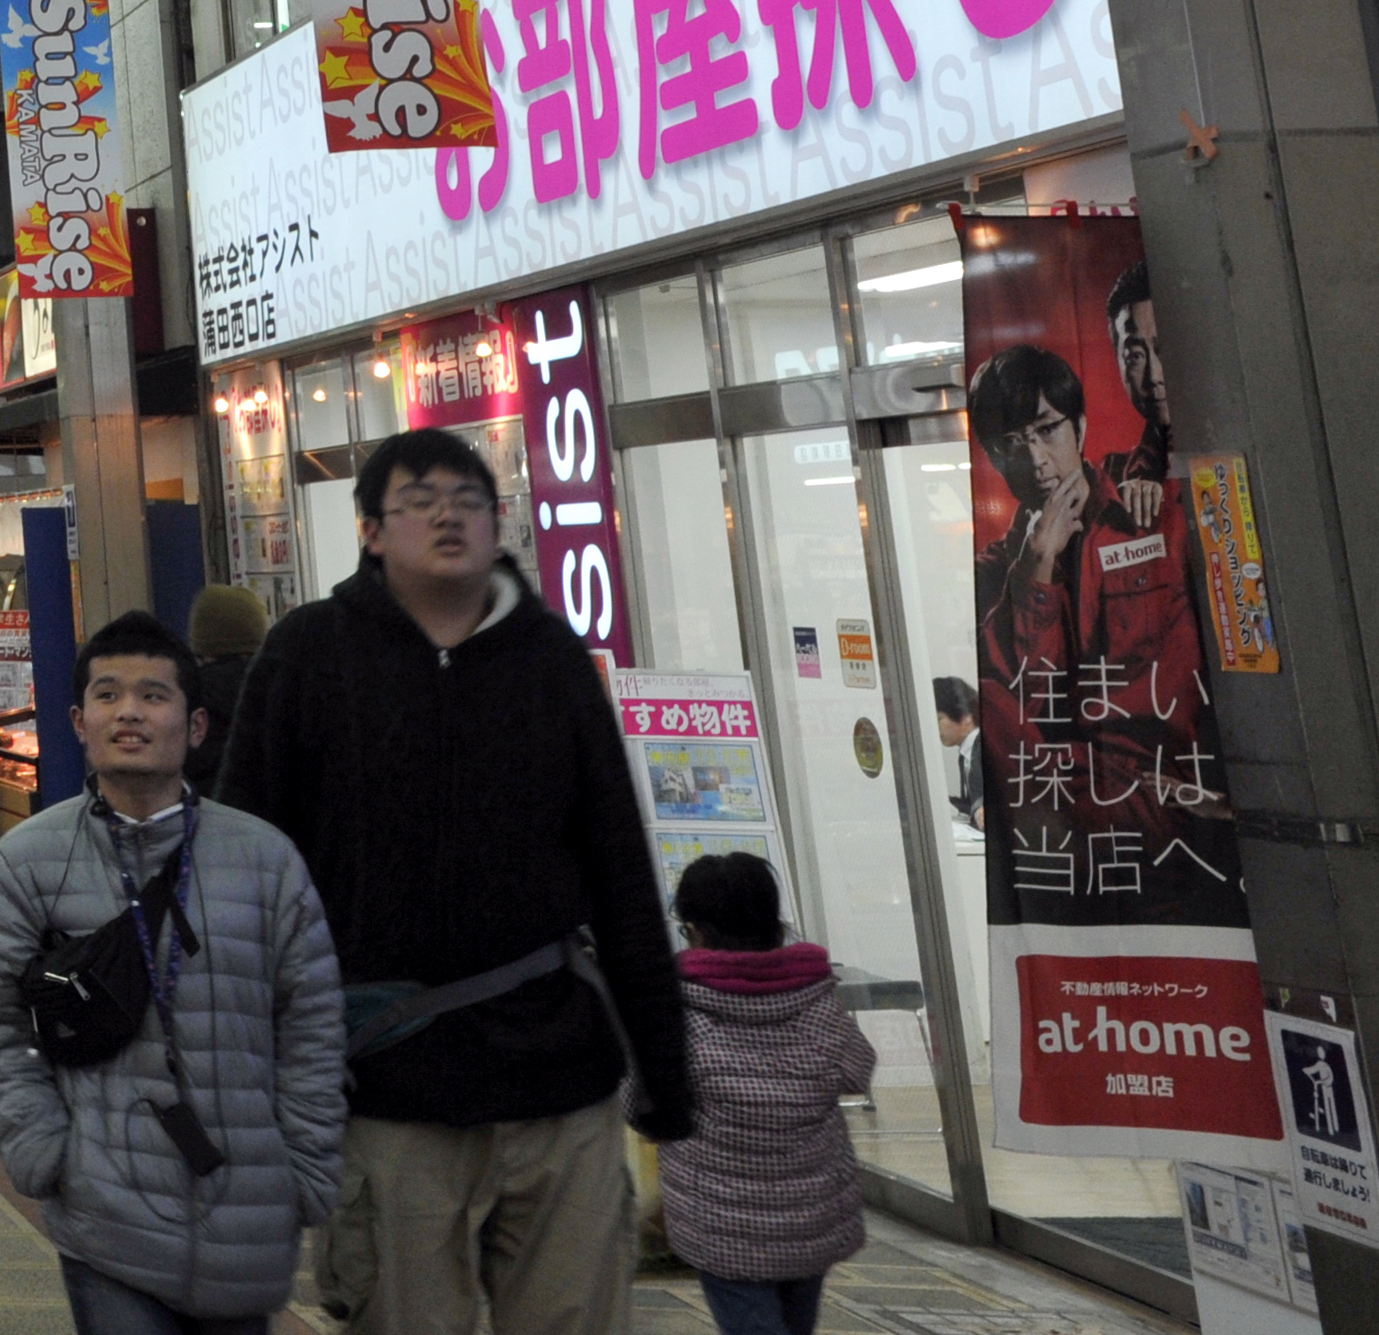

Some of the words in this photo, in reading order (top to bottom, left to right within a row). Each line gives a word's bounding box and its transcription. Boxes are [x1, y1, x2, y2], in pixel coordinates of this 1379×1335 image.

[14, 88, 40, 188] KAMATA
[198, 214, 320, 300] 株式会社アシスト
[201, 290, 277, 356] 蒲田西口店
[529, 299, 614, 642] sist
[1214, 462, 1252, 647] ゆっくりショッピング
[840, 637, 870, 657] D-room
[620, 701, 753, 736] すめ物件
[1008, 655, 1212, 725] 住まい
[1007, 741, 1227, 811] 探しは
[1060, 980, 1209, 1000] 不動産情報ネットワーク
[1105, 1073, 1175, 1098] 加盟店
